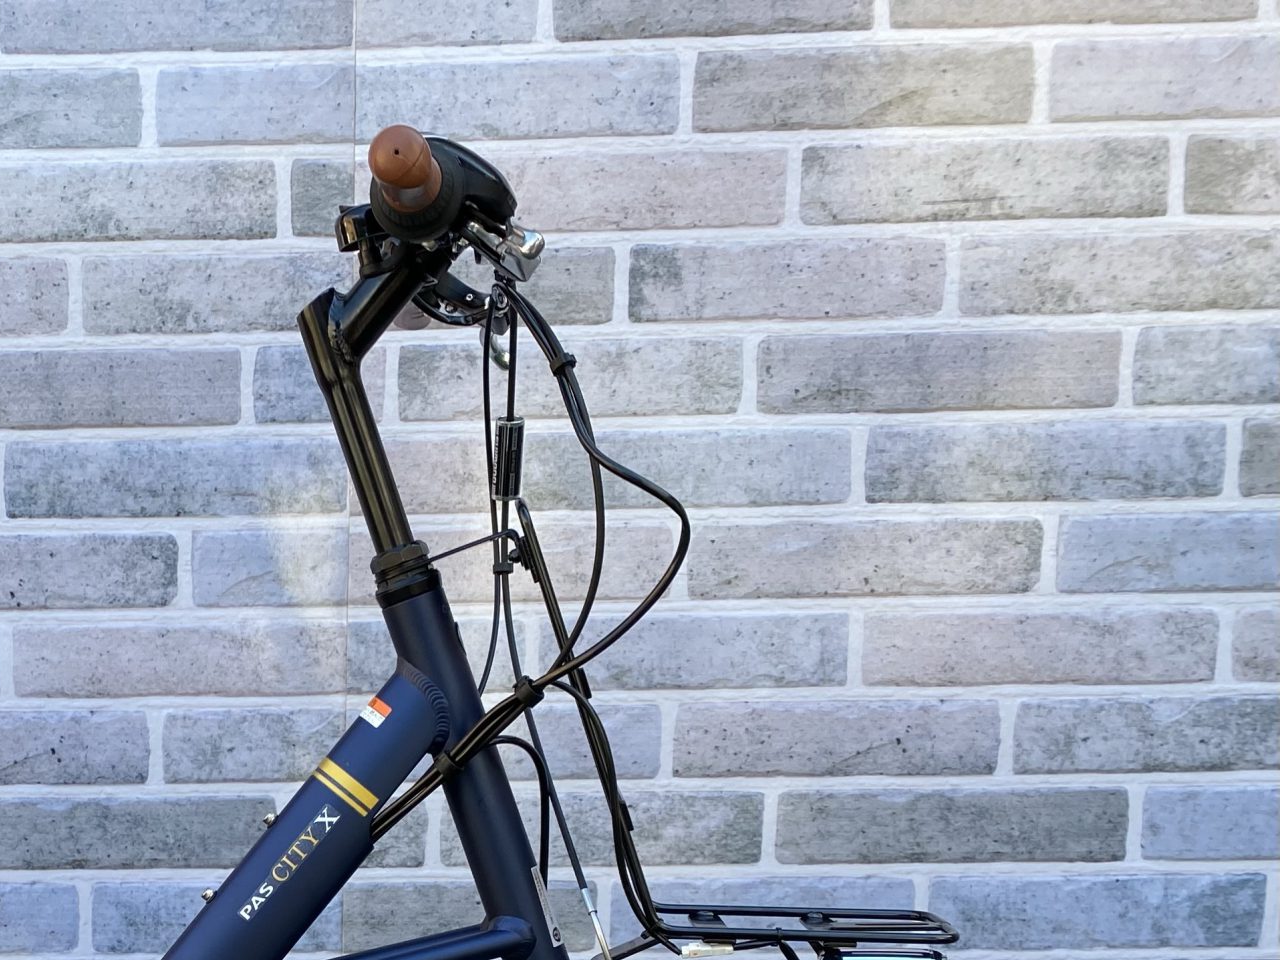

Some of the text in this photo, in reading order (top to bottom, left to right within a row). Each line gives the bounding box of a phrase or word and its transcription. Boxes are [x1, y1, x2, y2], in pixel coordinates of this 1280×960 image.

[239, 807, 341, 921] PAS CITY X
